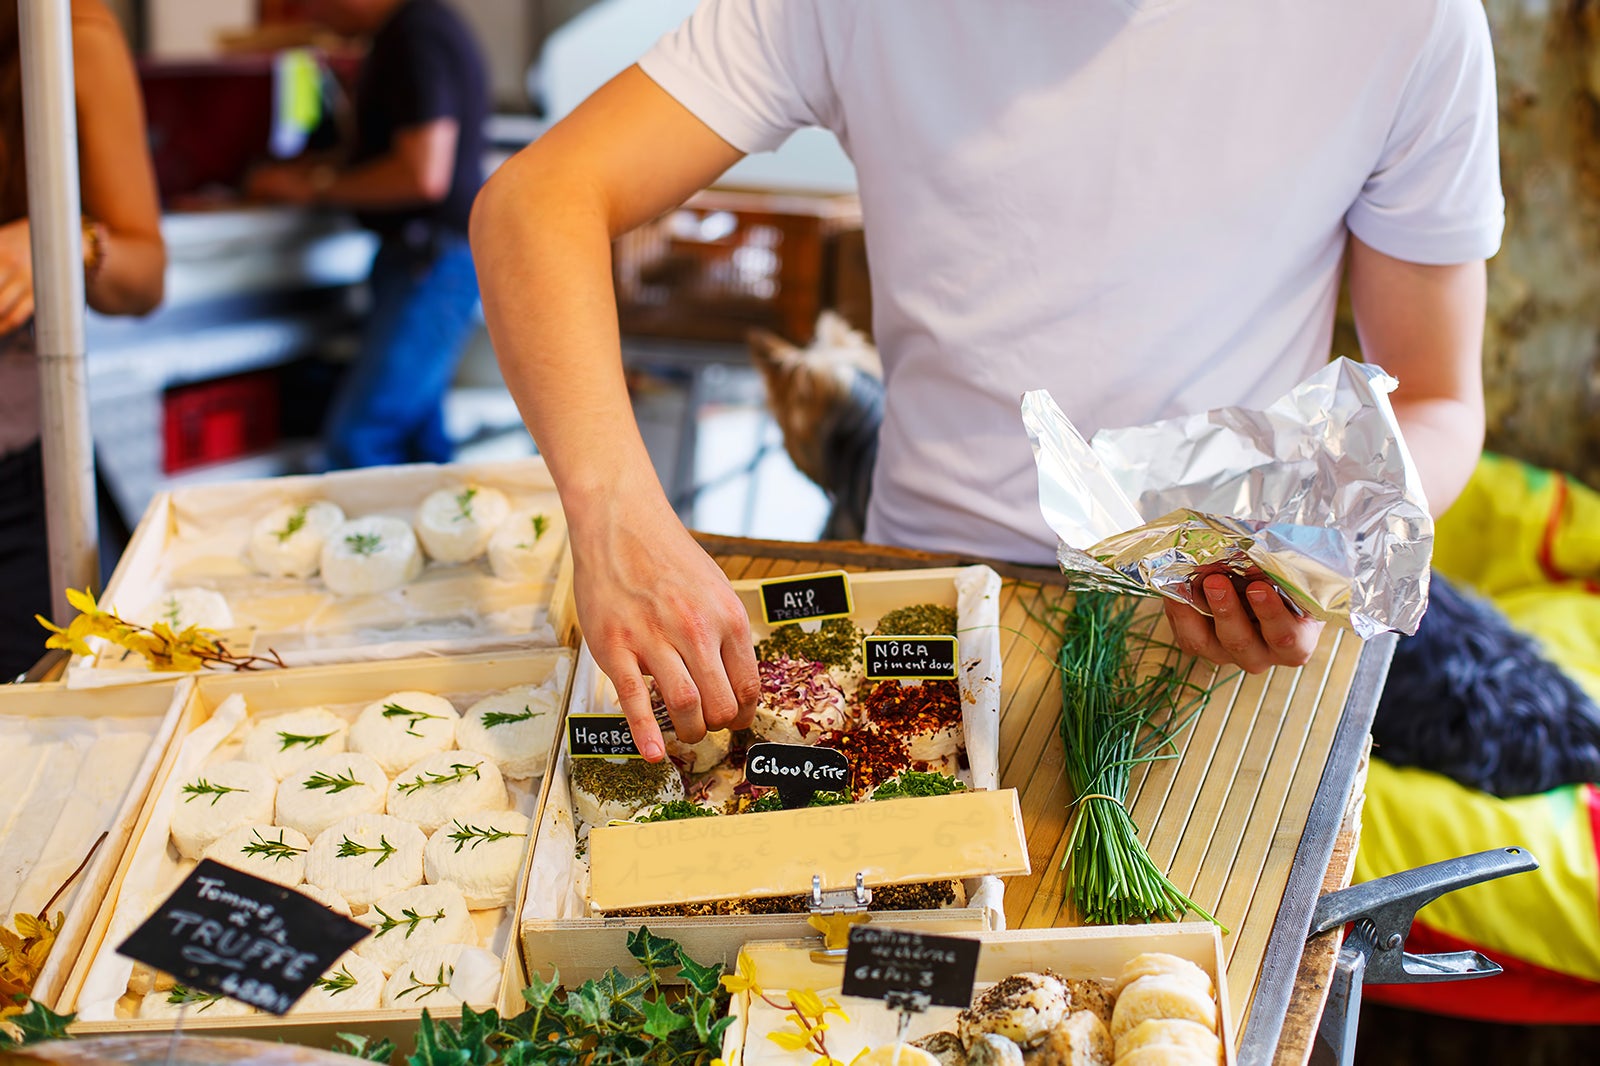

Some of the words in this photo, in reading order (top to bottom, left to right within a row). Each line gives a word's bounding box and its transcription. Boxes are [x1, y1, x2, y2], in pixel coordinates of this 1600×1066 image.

[774, 605, 825, 620] PERSIL
[873, 659, 927, 673] piment
[828, 830, 862, 863] 3
[197, 875, 275, 920] Tomme
[167, 908, 320, 982] TRUFFE
